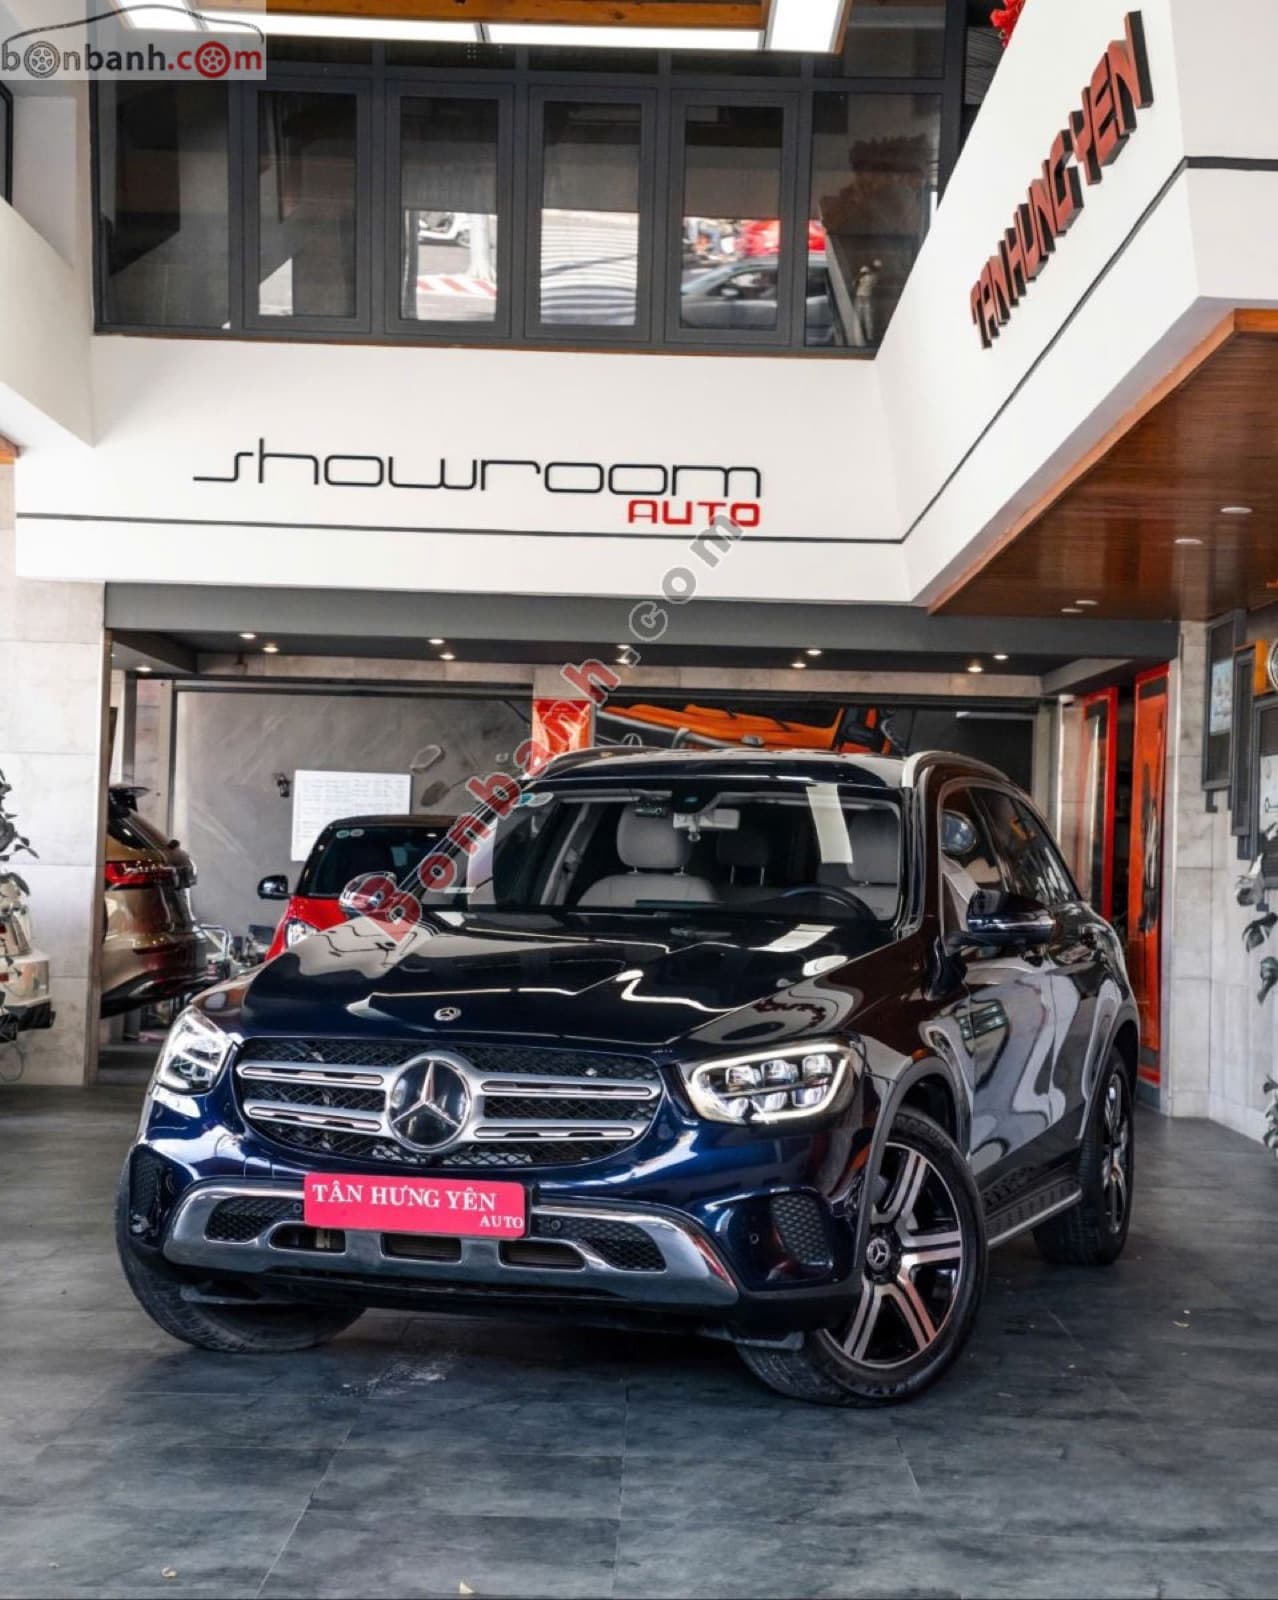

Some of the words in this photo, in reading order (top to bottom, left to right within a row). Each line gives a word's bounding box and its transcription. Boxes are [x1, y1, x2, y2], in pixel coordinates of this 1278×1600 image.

[193, 437, 762, 498] showroom
[627, 499, 760, 528] AUTO
[311, 1179, 364, 1203] TÂN
[371, 1184, 441, 1209] HƯNG
[446, 1186, 497, 1213] YÊN
[480, 1214, 524, 1230] AUTO
